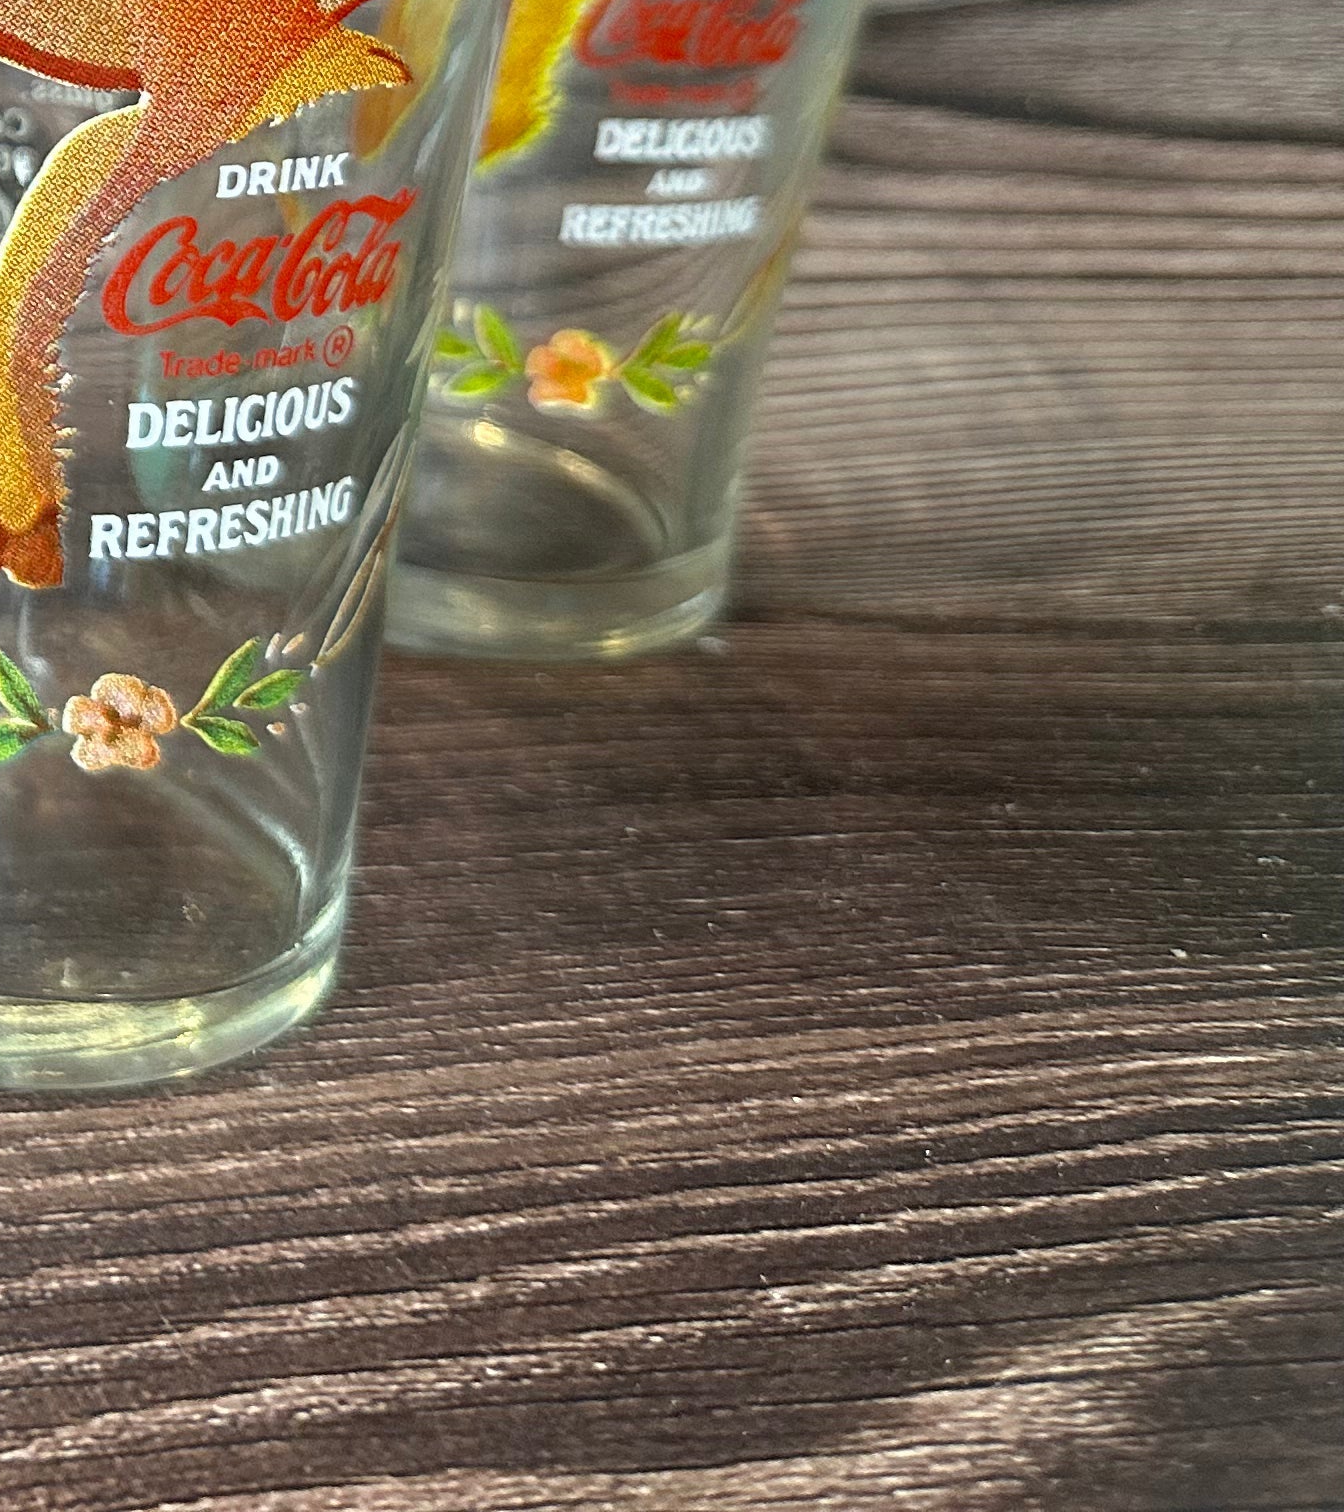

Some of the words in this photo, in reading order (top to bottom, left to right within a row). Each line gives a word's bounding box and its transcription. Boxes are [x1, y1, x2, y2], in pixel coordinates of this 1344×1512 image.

[594, 114, 770, 164] DELICIOUS
[214, 152, 352, 200] DRINK
[558, 195, 762, 248] REFRESHING
[100, 187, 418, 337] Coca-Cola
[158, 337, 317, 380] Trade-mark
[125, 376, 355, 450] DELICIOUS
[201, 455, 280, 493] AND
[88, 475, 353, 561] REFRESHING
